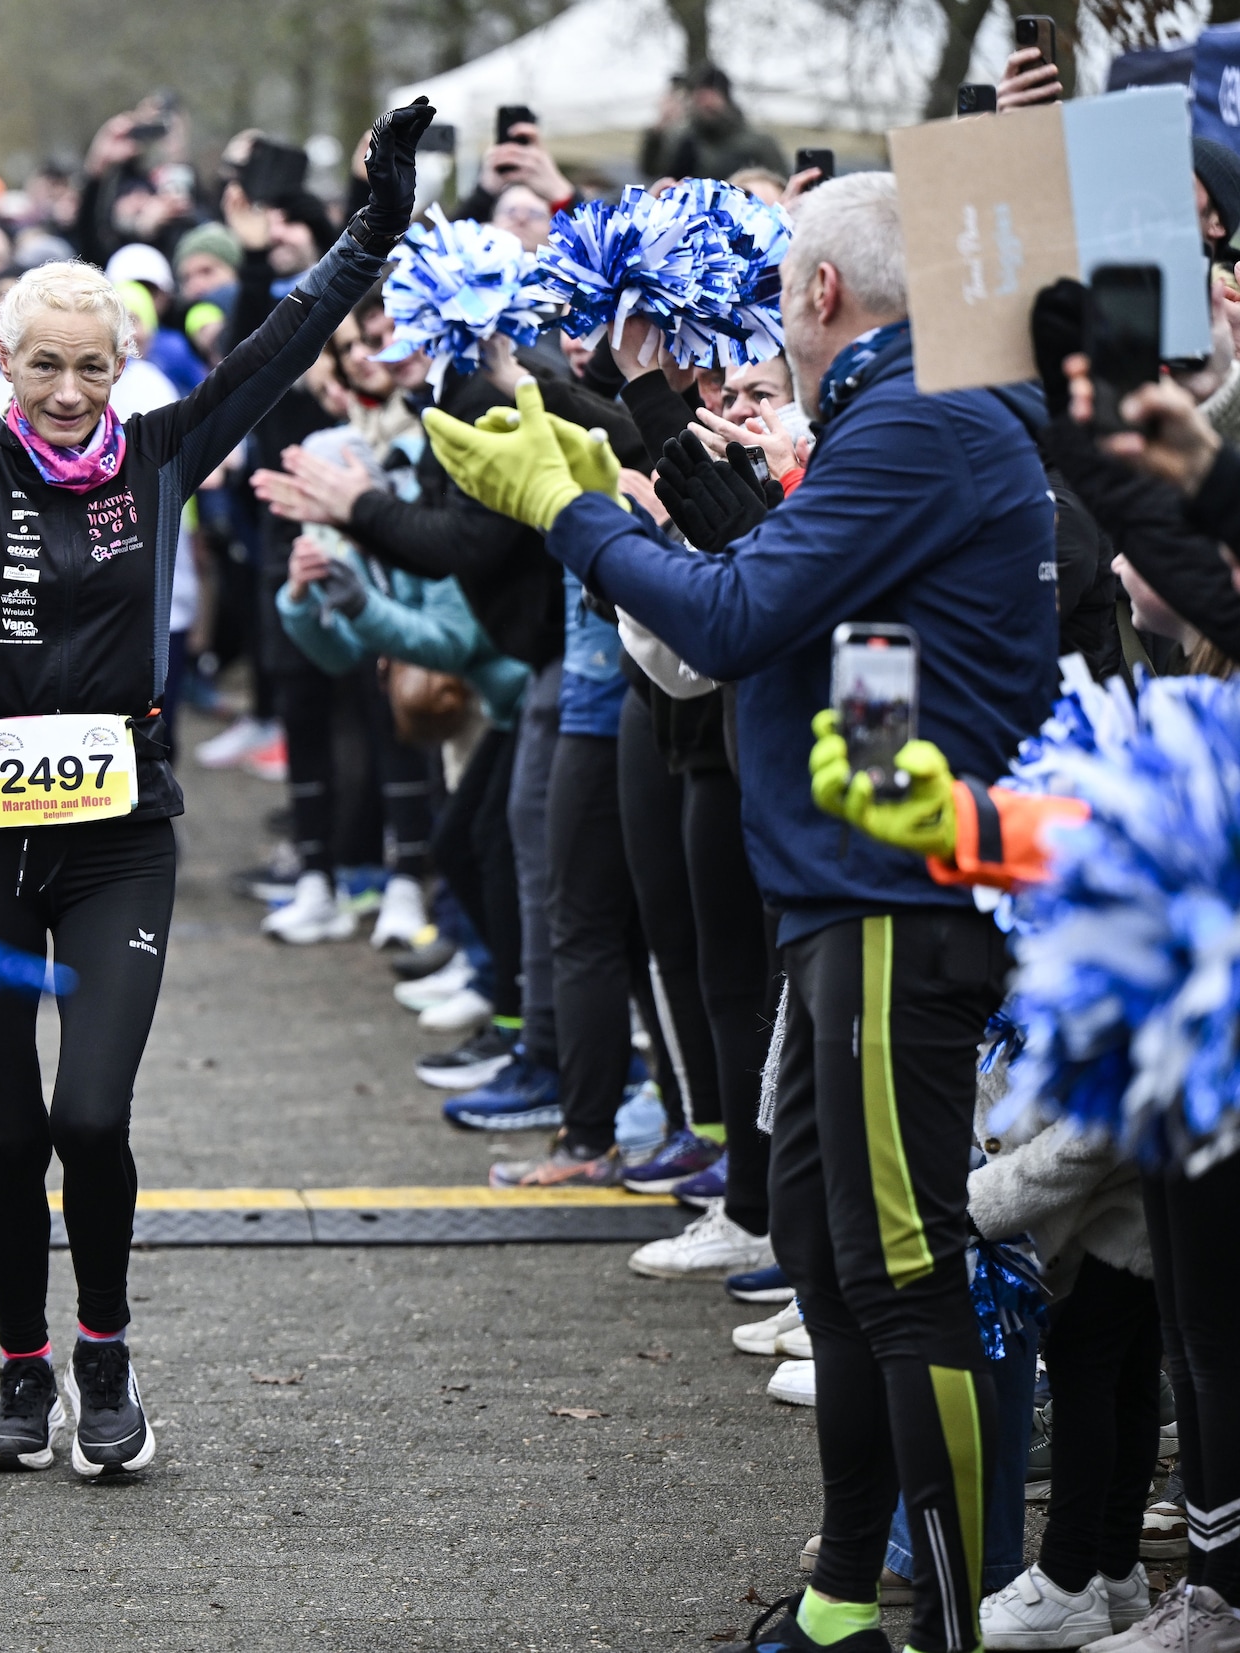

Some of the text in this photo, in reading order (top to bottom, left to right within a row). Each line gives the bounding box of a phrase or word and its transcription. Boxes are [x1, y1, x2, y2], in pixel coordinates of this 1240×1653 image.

[128, 542, 144, 551] cancer
[2, 607, 35, 616] WrelaxU
[2, 618, 35, 630] Vano
[0, 753, 114, 795] 2497
[2, 796, 112, 813] Marathon and More
[43, 811, 74, 820] Belgium
[129, 939, 158, 956] erima
